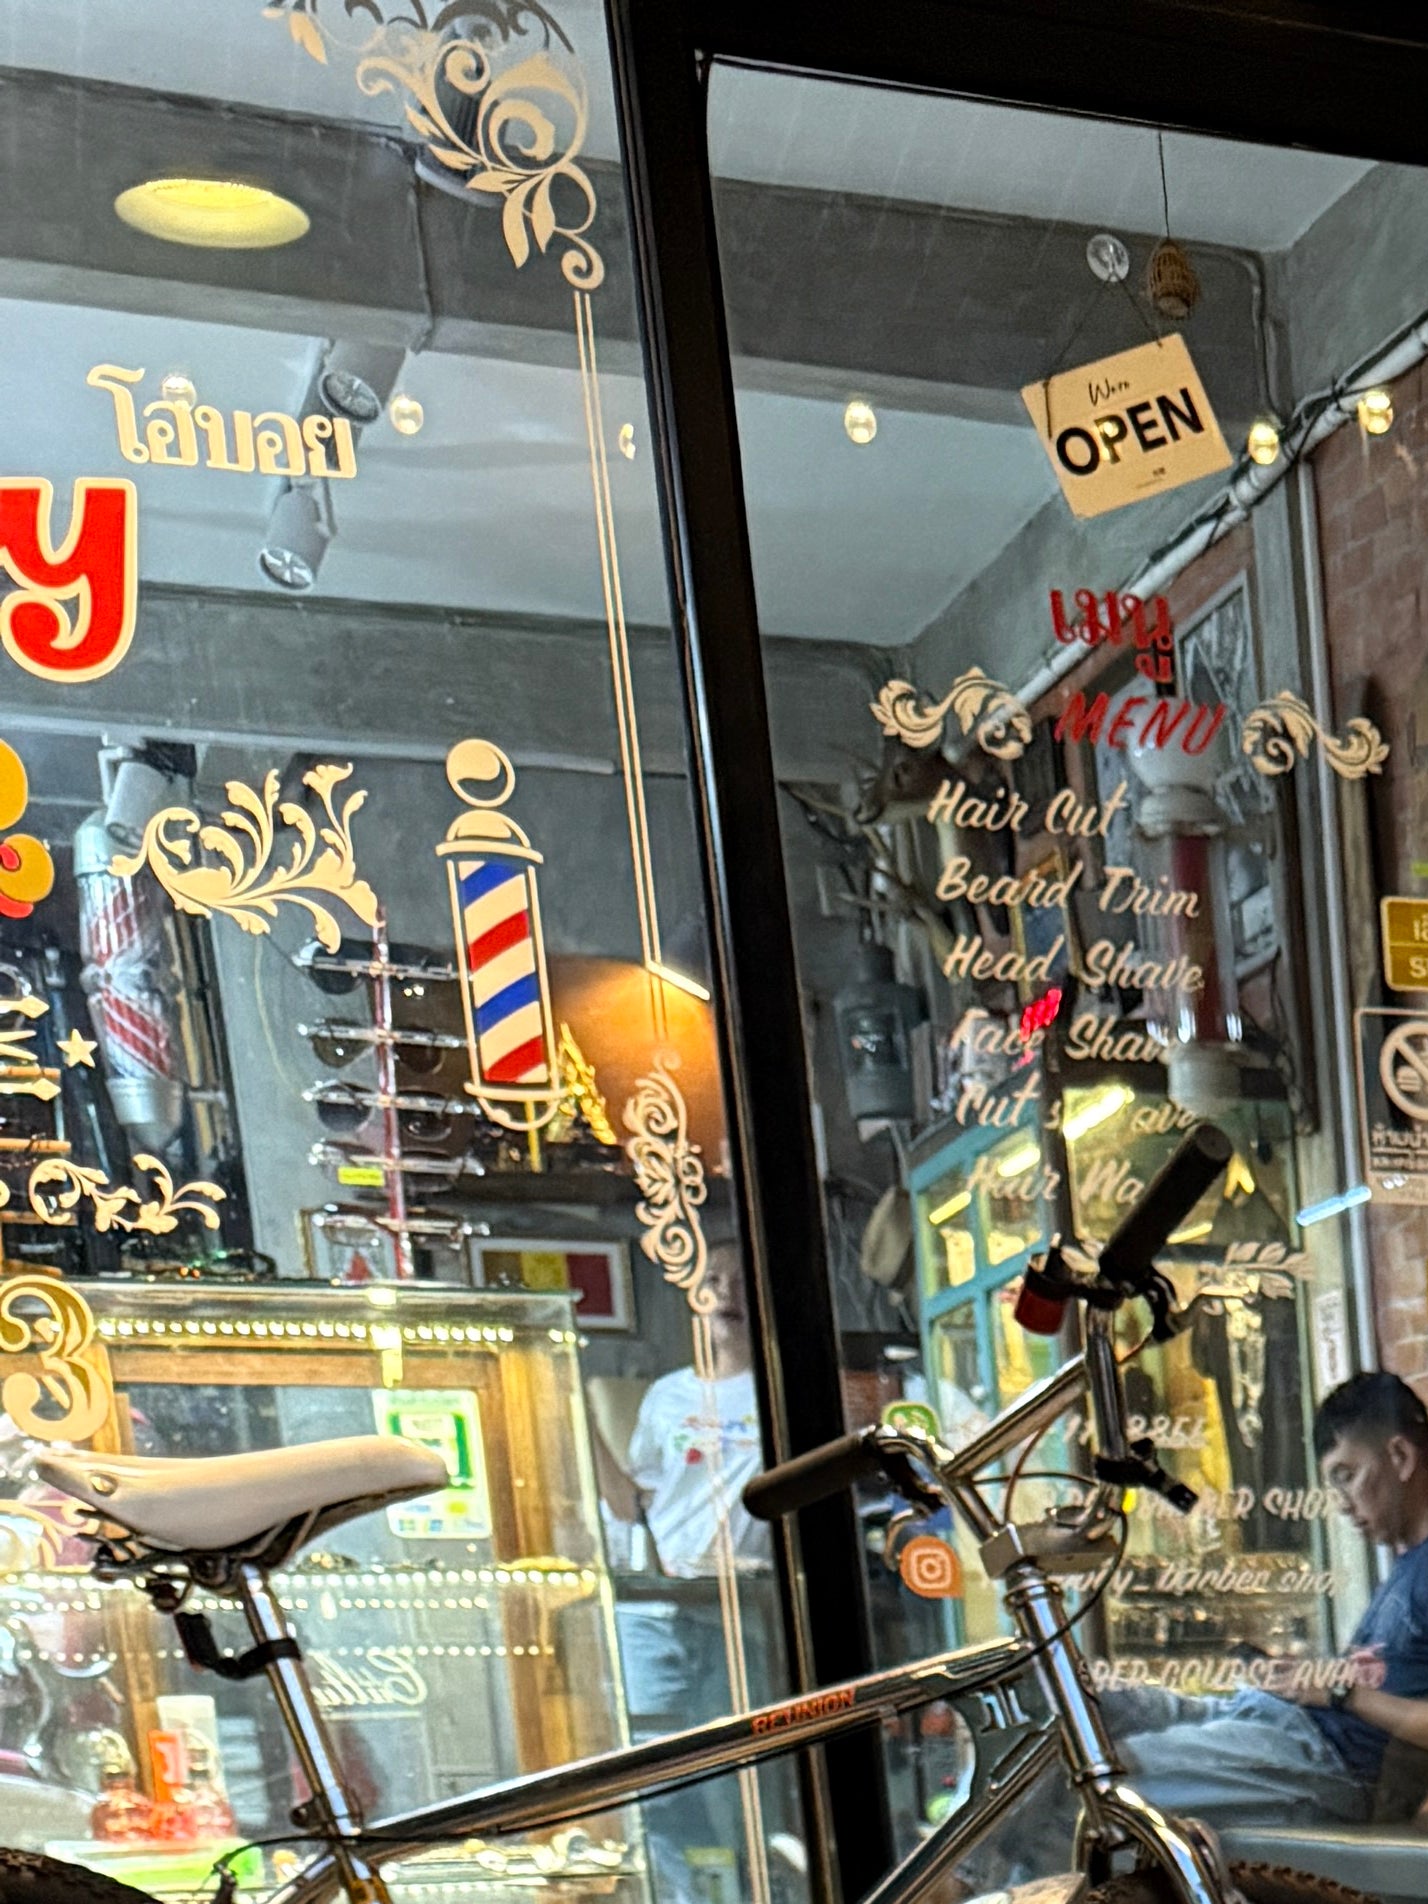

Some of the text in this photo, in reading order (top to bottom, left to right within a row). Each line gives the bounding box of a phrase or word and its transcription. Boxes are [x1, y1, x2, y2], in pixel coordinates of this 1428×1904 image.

[1055, 387, 1205, 476] OPEN
[1053, 690, 1226, 757] MENU
[927, 779, 1129, 837] Hair Cut
[935, 855, 1202, 919] Beard Trim
[944, 934, 1205, 993] Head Shave
[1079, 1160, 1144, 1205] Wa
[751, 1688, 857, 1736] REUNION
